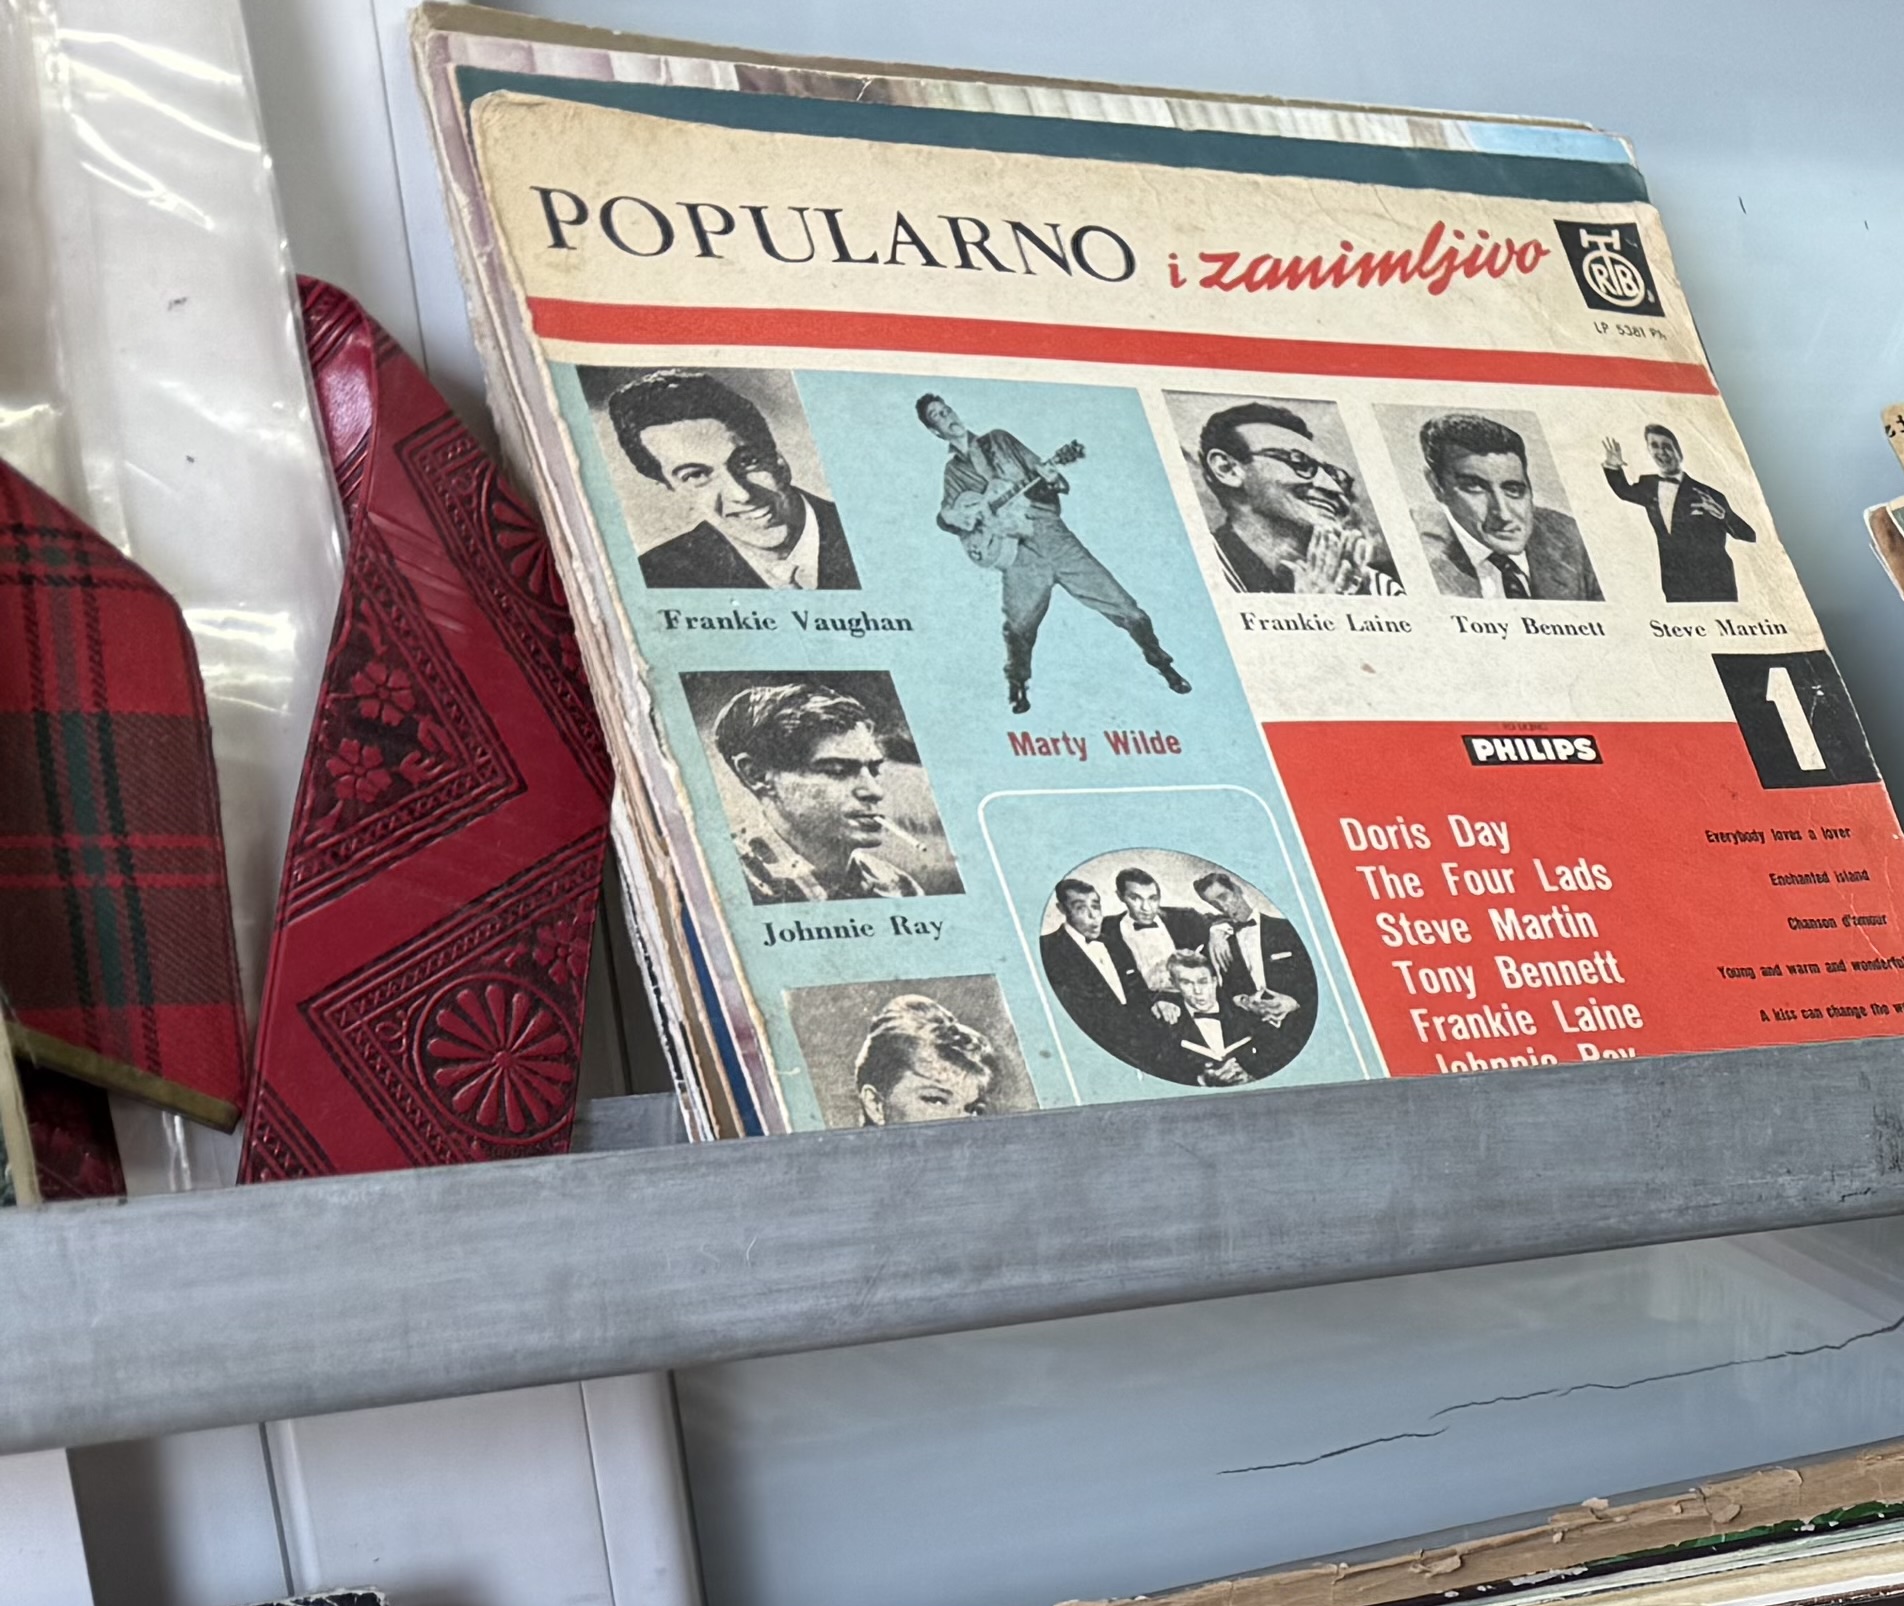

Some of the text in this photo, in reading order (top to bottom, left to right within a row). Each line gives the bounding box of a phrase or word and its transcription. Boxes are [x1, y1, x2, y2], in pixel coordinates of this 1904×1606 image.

[529, 185, 1549, 298] POPULARNO i zanimljivo
[657, 607, 915, 640] Frankie Vaughan
[1238, 610, 1413, 638] Frankie Laine
[1452, 614, 1606, 643] Tony Bennett
[1650, 616, 1789, 642] Steve Martin
[1765, 667, 1827, 772] 1
[1006, 726, 1182, 763] Marty Wilde
[1471, 737, 1597, 763] PHILIPS
[1340, 813, 1512, 857] Doris Day
[1705, 826, 1851, 845] Everybody loves a lover
[1356, 857, 1614, 902] The Four Lads
[1769, 869, 1870, 886] Enchanted island
[762, 914, 946, 947] Johnnie Ray
[1374, 904, 1600, 949] Steve Martin
[1787, 916, 1837, 931] Chanson
[1392, 950, 1626, 1000] Tony Bennett
[1717, 966, 1756, 980] Young
[1760, 964, 1783, 977] and
[1787, 963, 1821, 975] warm
[1825, 959, 1847, 972] and
[1410, 998, 1644, 1044] Frankie Laine
[1760, 1009, 1770, 1022] A
[1802, 1007, 1824, 1019] can
[1826, 1004, 1868, 1020] change
[1871, 1003, 1890, 1015] the
